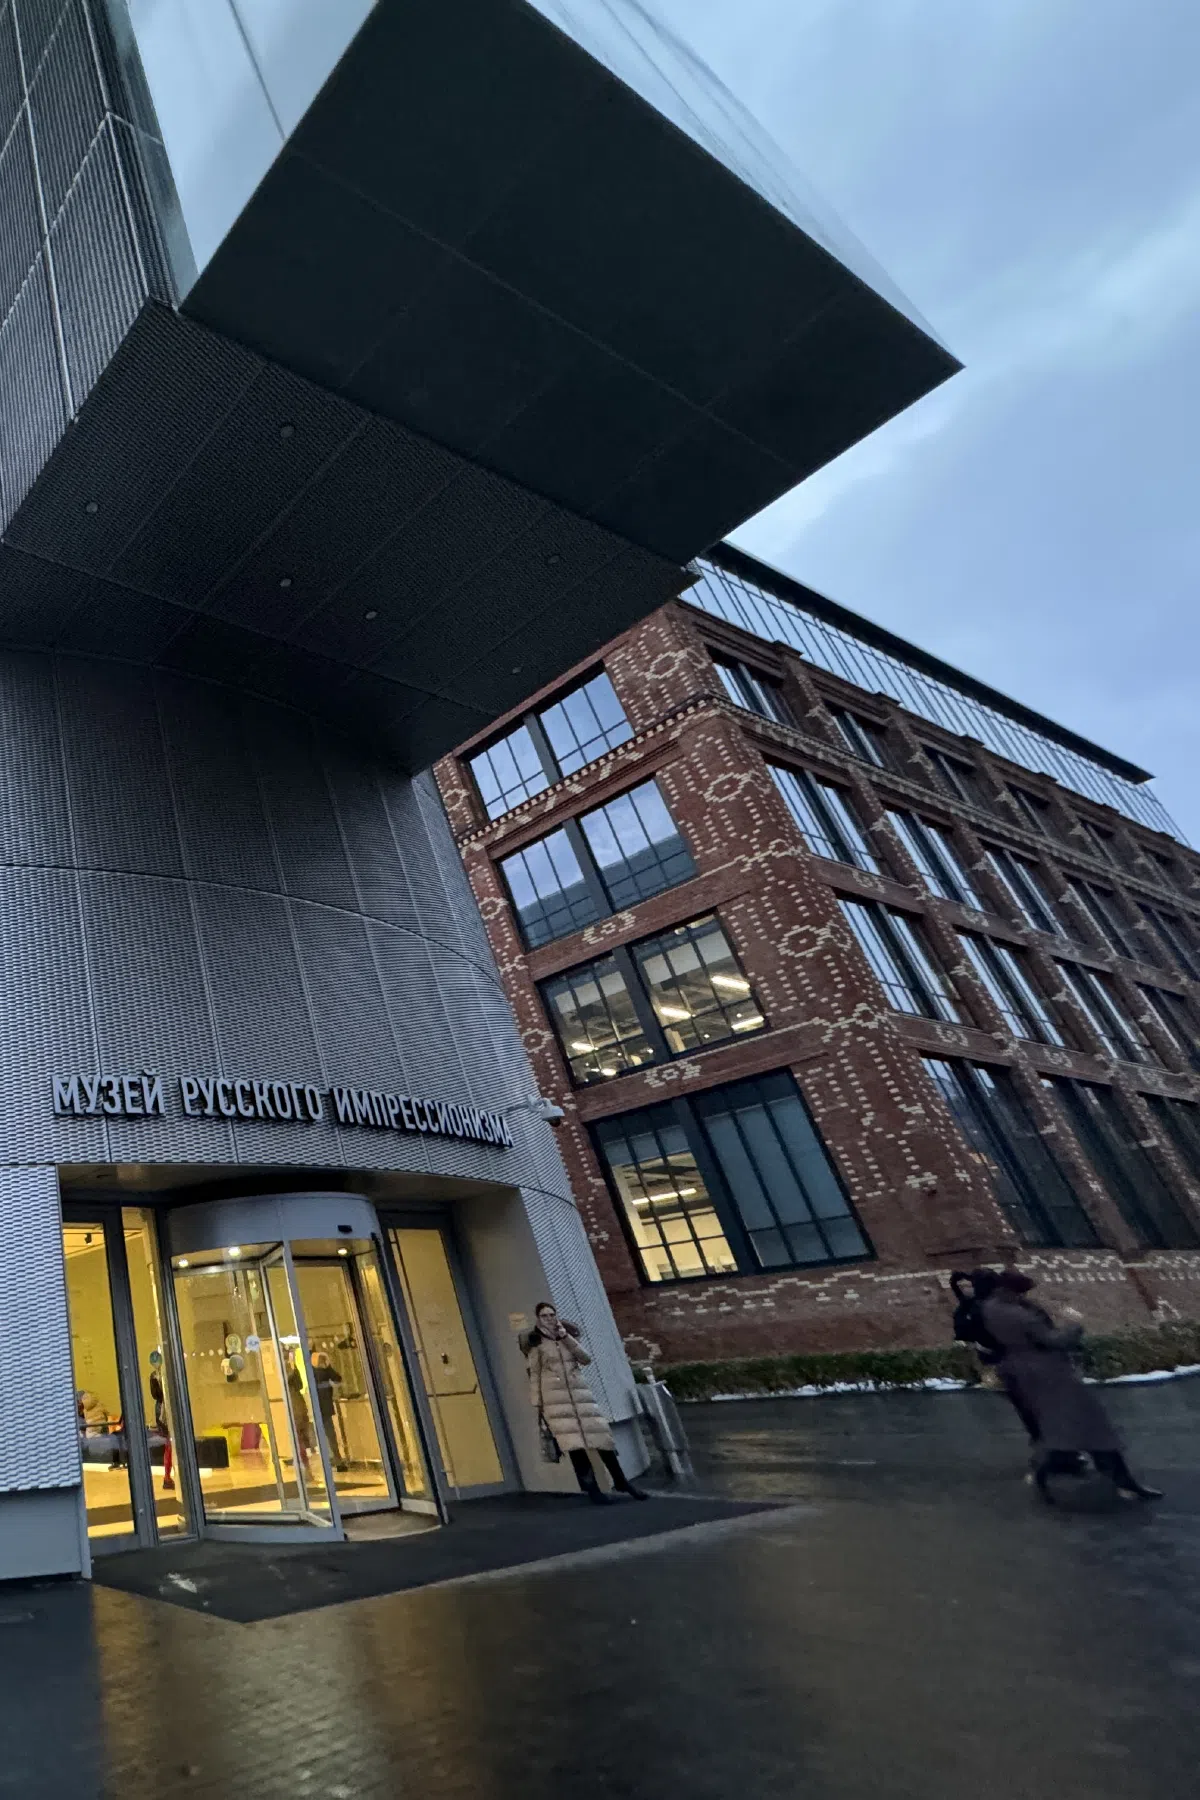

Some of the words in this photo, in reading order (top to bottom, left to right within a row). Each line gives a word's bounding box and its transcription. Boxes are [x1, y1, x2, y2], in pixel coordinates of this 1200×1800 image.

[52, 1068, 165, 1115] МУЗЕЙ
[180, 1077, 324, 1121] РУССКОГО
[332, 1087, 514, 1148] ИМПРЕССИОНИЗМА
